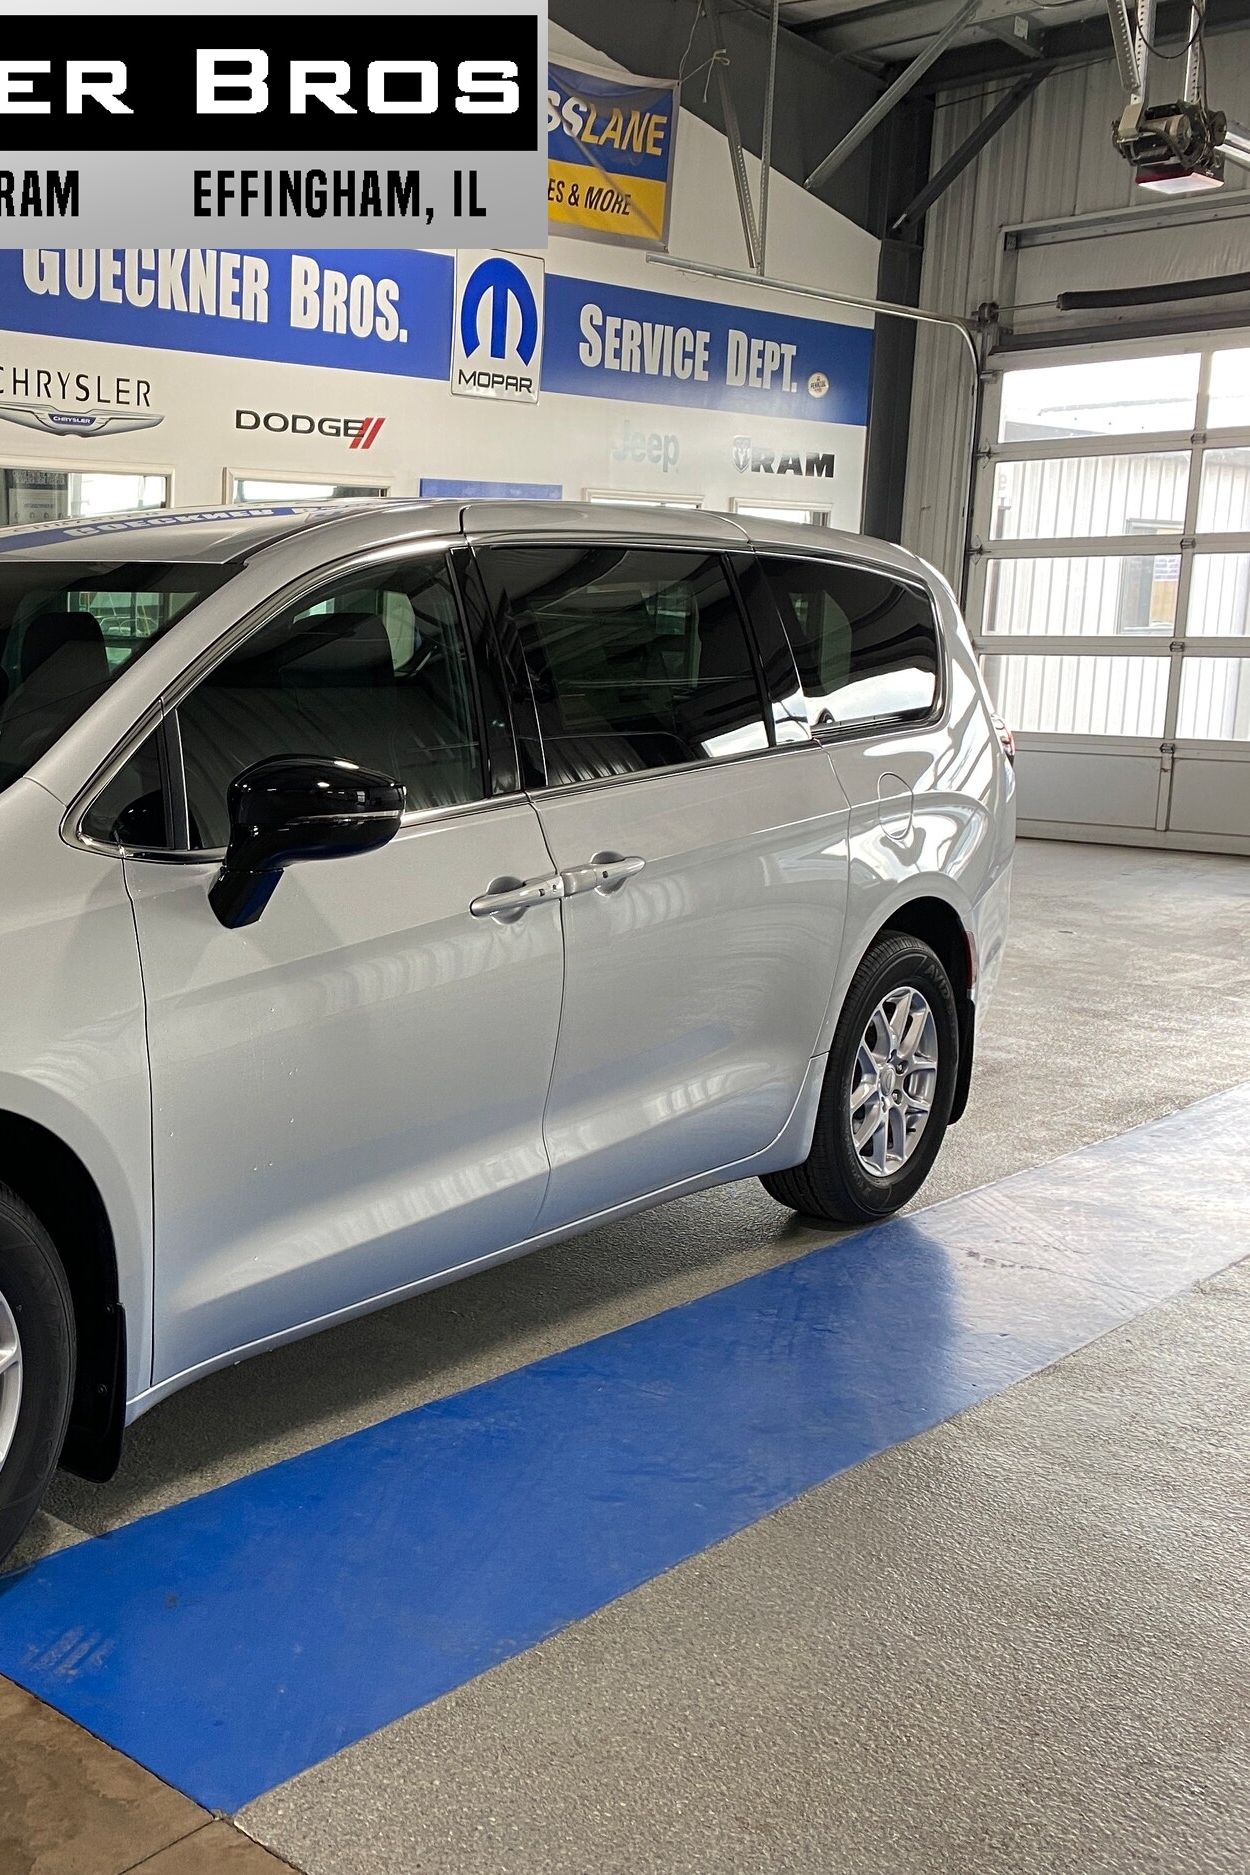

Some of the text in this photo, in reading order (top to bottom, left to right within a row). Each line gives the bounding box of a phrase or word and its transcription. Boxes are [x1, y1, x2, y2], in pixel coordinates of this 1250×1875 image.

[567, 182, 581, 207] &
[584, 186, 632, 216] MORE
[23, 248, 409, 343] GOECKNER BROS.
[578, 303, 799, 393] SERVICE DEPT.
[458, 368, 534, 394] MOPAR
[52, 415, 92, 424] CHRYSLER
[235, 409, 366, 438] DODGE
[613, 419, 680, 473] Jeep
[750, 445, 835, 478] RAM
